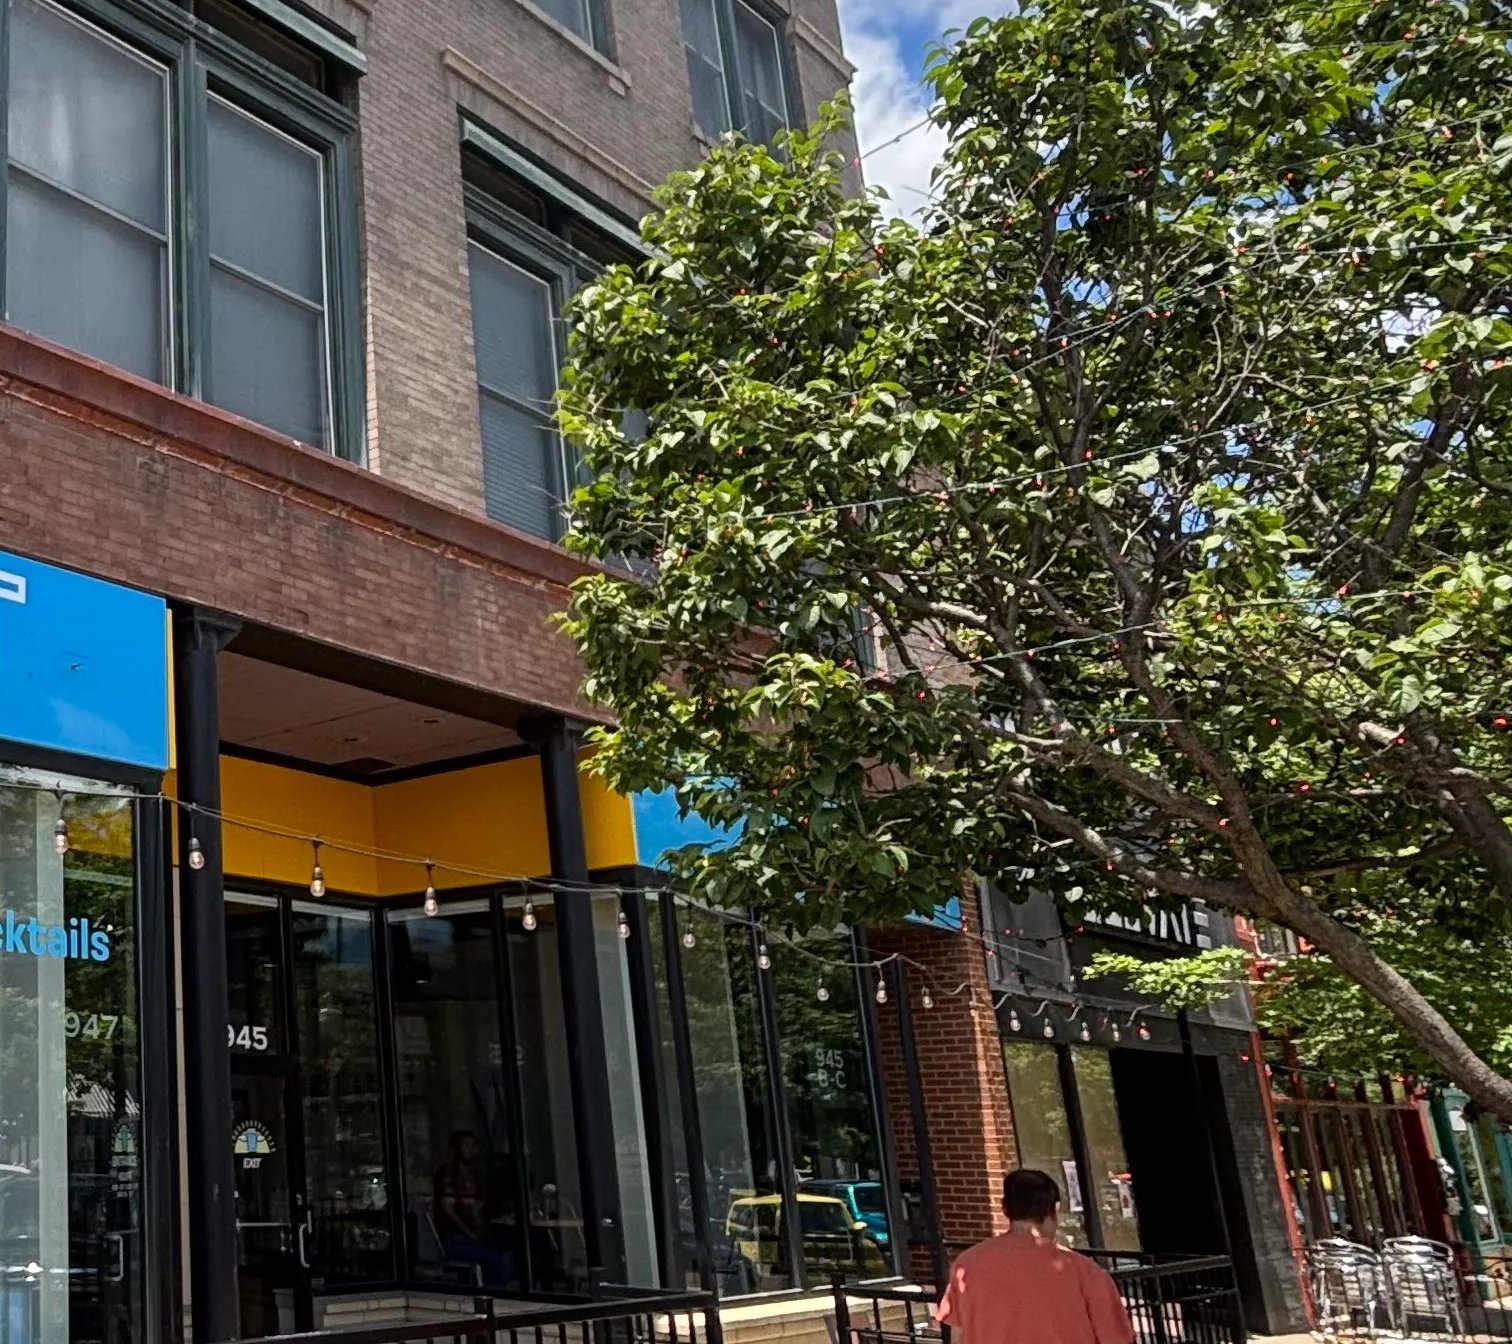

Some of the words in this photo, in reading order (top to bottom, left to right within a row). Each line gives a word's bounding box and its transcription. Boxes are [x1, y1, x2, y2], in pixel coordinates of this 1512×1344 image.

[65, 1011, 118, 1040] 947
[814, 1048, 844, 1069] 945
[817, 1068, 847, 1089] B-C
